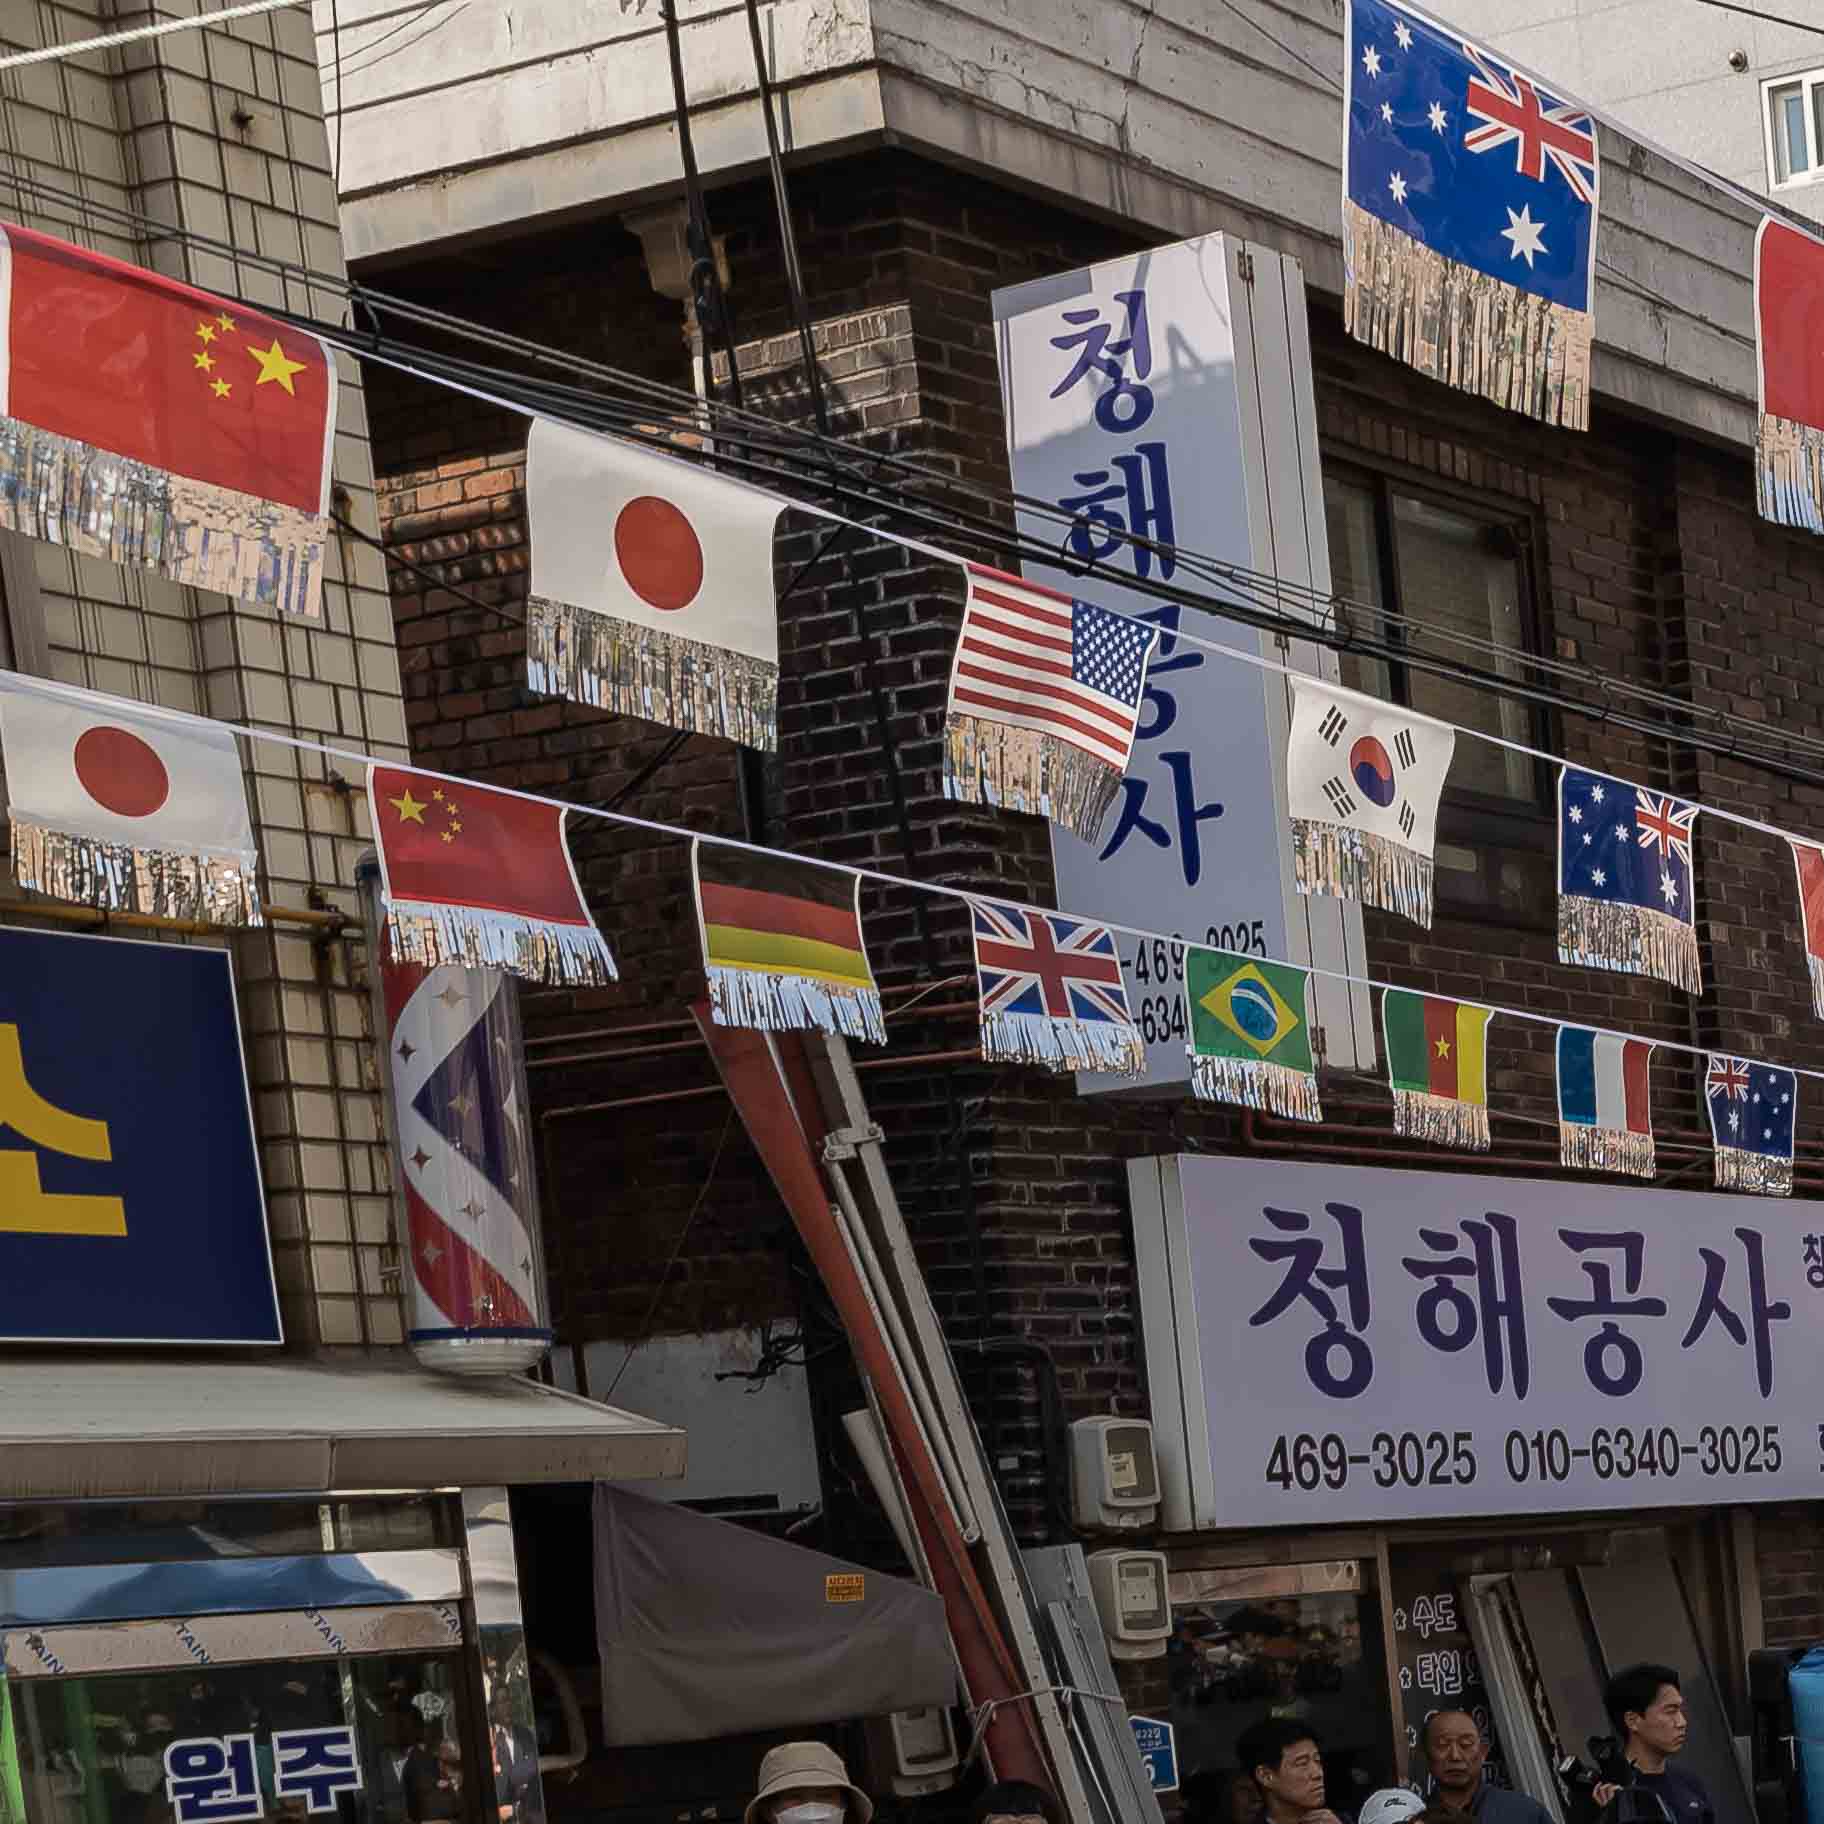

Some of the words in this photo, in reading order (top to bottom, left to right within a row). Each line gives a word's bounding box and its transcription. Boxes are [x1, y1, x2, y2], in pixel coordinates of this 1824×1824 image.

[1248, 1201, 1792, 1401] 청해공사
[1264, 1431, 1478, 1491] 469-3025
[1504, 1424, 1783, 1483] 010-6340-3025
[1412, 1594, 1457, 1639] 수도
[1416, 1650, 1463, 1695] 타일
